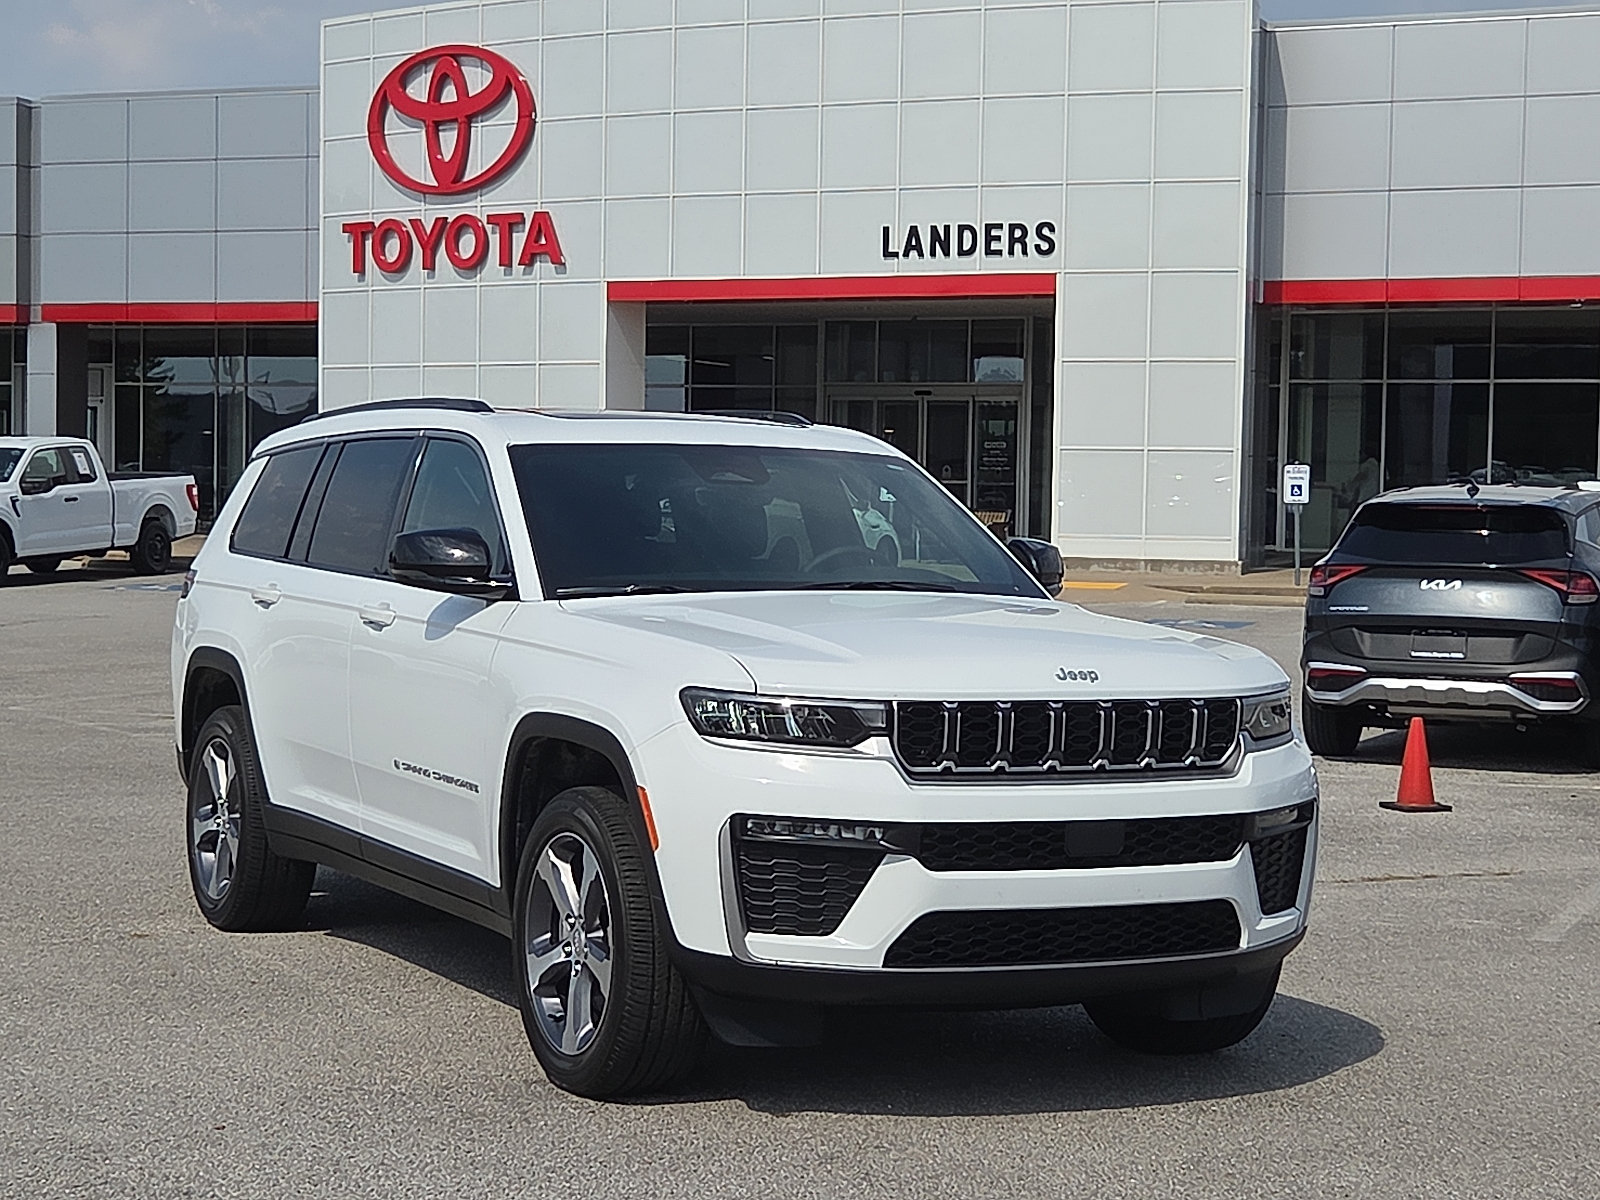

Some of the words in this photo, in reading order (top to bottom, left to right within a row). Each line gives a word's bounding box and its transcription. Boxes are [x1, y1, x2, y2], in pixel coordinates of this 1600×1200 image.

[342, 211, 566, 274] TOYOTA
[882, 221, 1056, 258] LANDERS
[1420, 579, 1462, 590] KIA
[1055, 667, 1099, 683] Jeep
